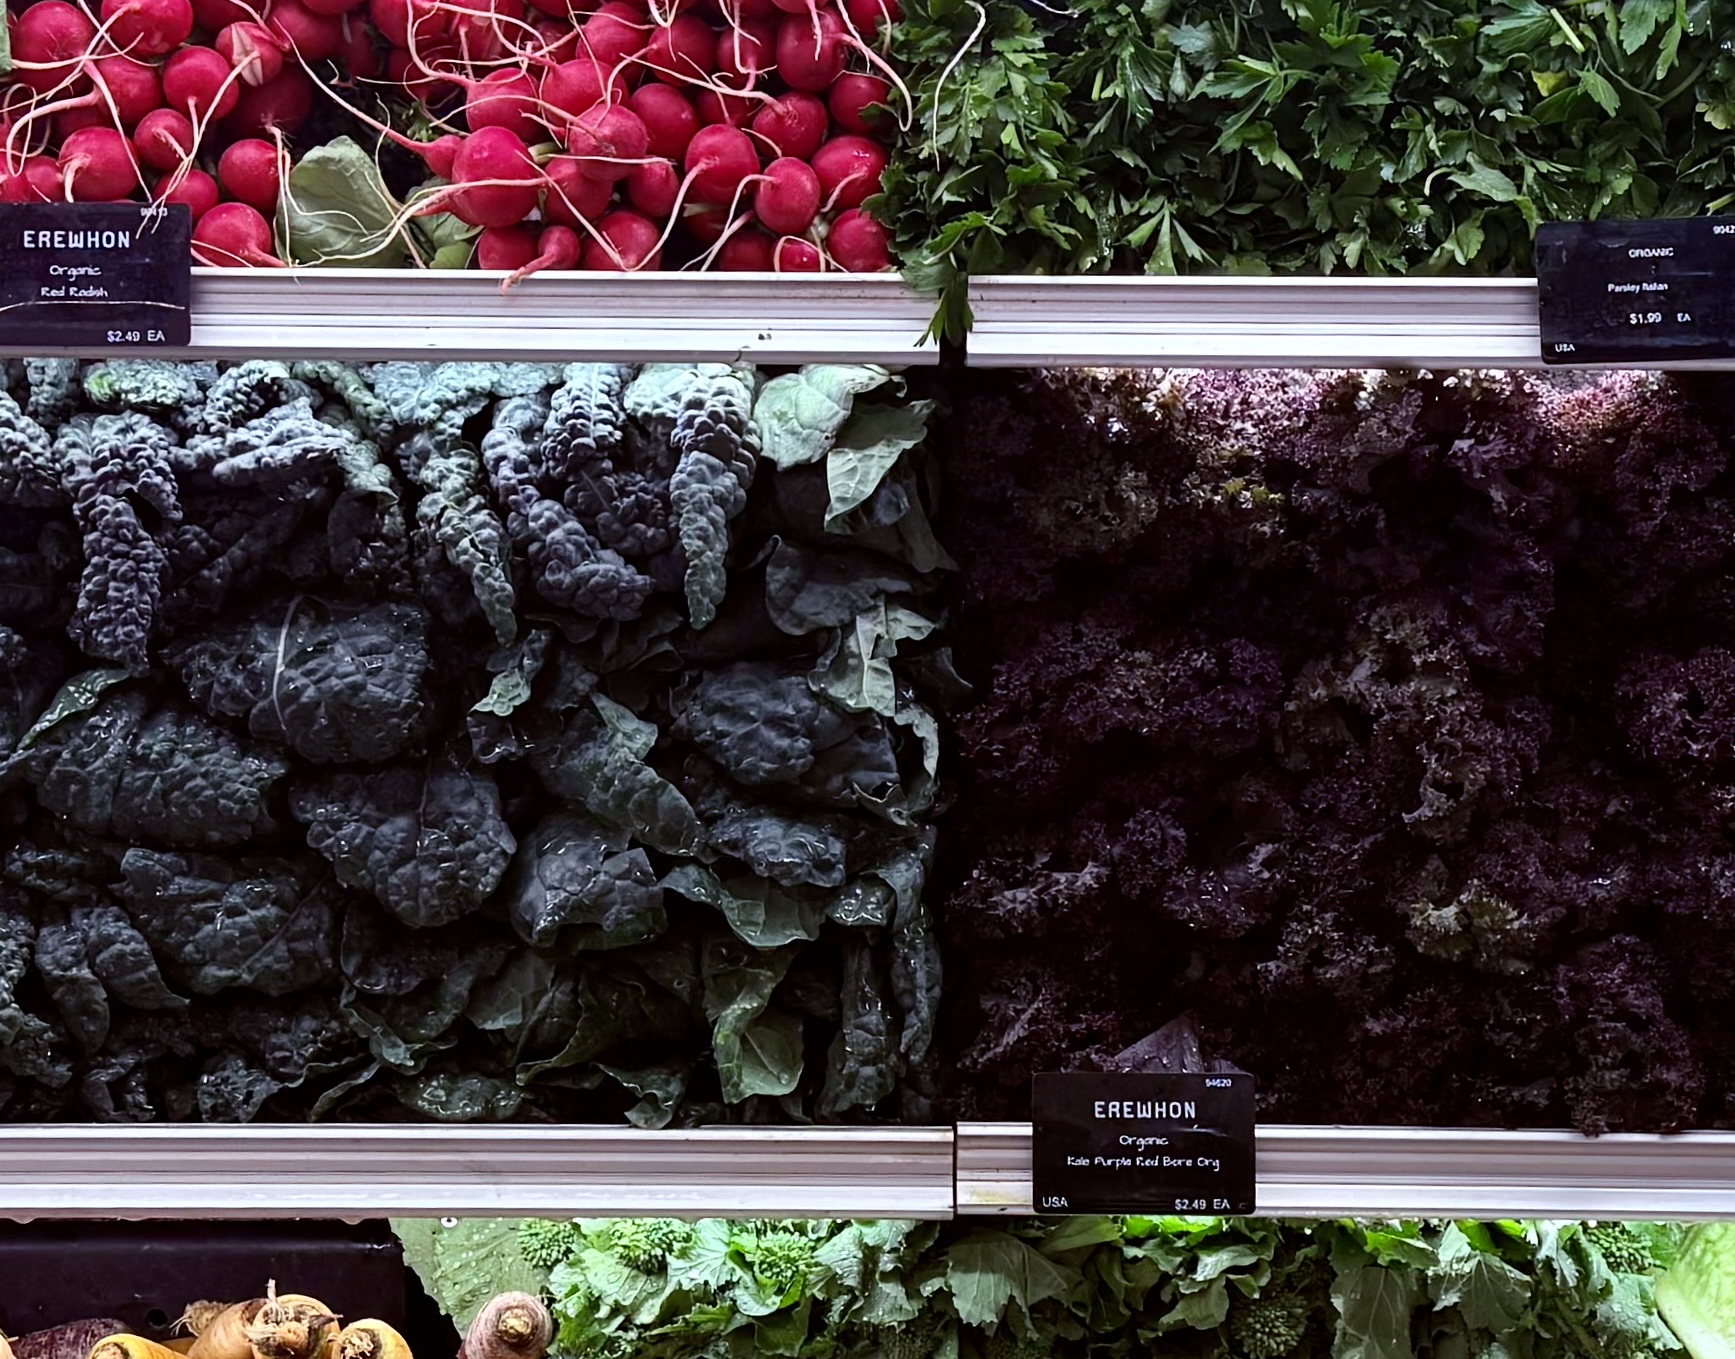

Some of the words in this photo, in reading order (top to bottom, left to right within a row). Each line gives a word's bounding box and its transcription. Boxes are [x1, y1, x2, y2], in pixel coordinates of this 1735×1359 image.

[24, 231, 129, 248] EREWHON
[1629, 248, 1674, 258] ORGANIC
[50, 265, 102, 281] Organic
[41, 287, 65, 297] Red
[69, 287, 108, 298] Radish
[1608, 283, 1640, 293] Parsley
[1630, 313, 1662, 324] $1.99
[1677, 313, 1691, 322] EA
[107, 331, 140, 342] $2.49
[148, 330, 165, 341] EA
[1555, 344, 1575, 352] USA
[1095, 1101, 1195, 1118] EREWHON
[1119, 1135, 1169, 1151] Organic
[1067, 1156, 1090, 1166] Kale
[1094, 1156, 1131, 1170] Purple
[1136, 1156, 1158, 1166] Red
[1163, 1157, 1192, 1166] Bore
[1197, 1157, 1220, 1171] Org
[1042, 1197, 1068, 1207] USA
[1175, 1199, 1206, 1210] $2.49
[1214, 1199, 1230, 1209] EA
